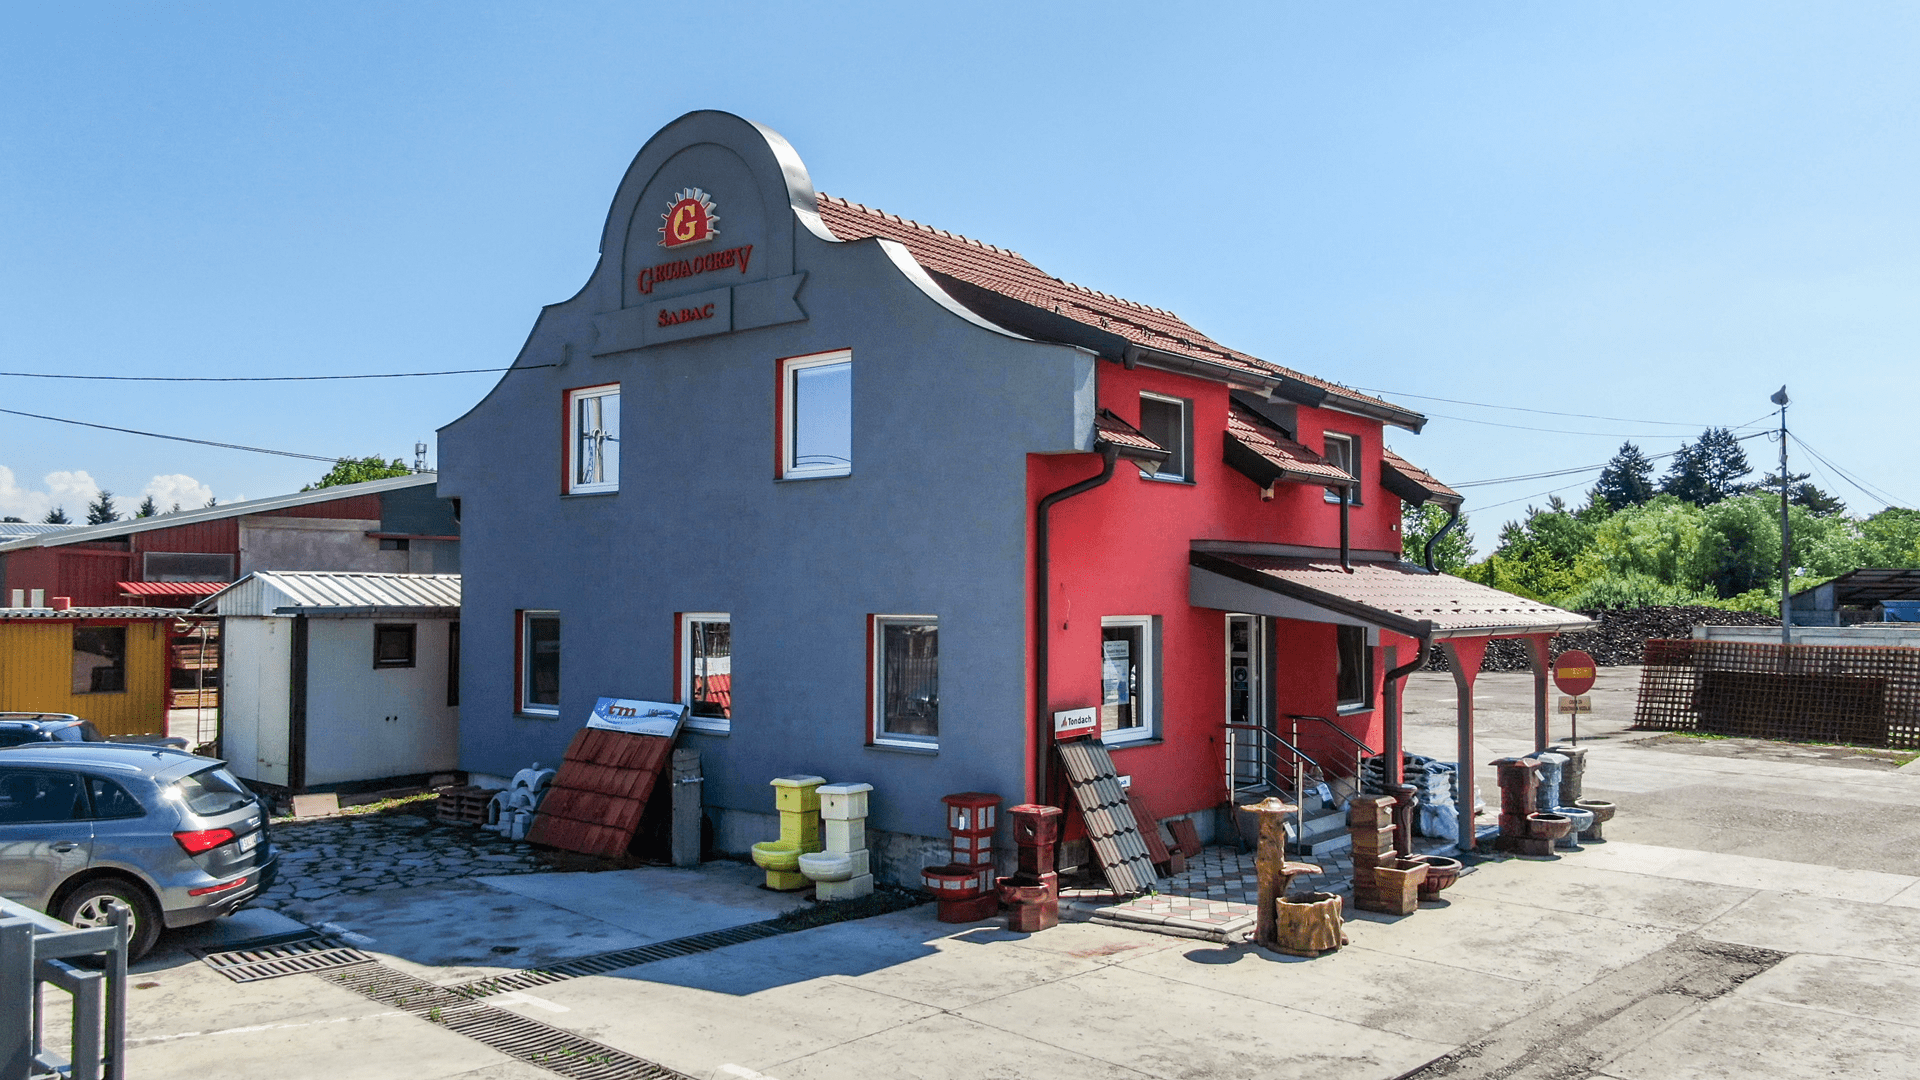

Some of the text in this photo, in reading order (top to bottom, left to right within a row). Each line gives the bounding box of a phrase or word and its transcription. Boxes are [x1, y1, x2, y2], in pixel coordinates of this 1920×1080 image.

[673, 204, 697, 241] G
[693, 244, 753, 274] OGREV
[657, 303, 714, 327] ŠABAC
[1068, 715, 1091, 726] Tondach
